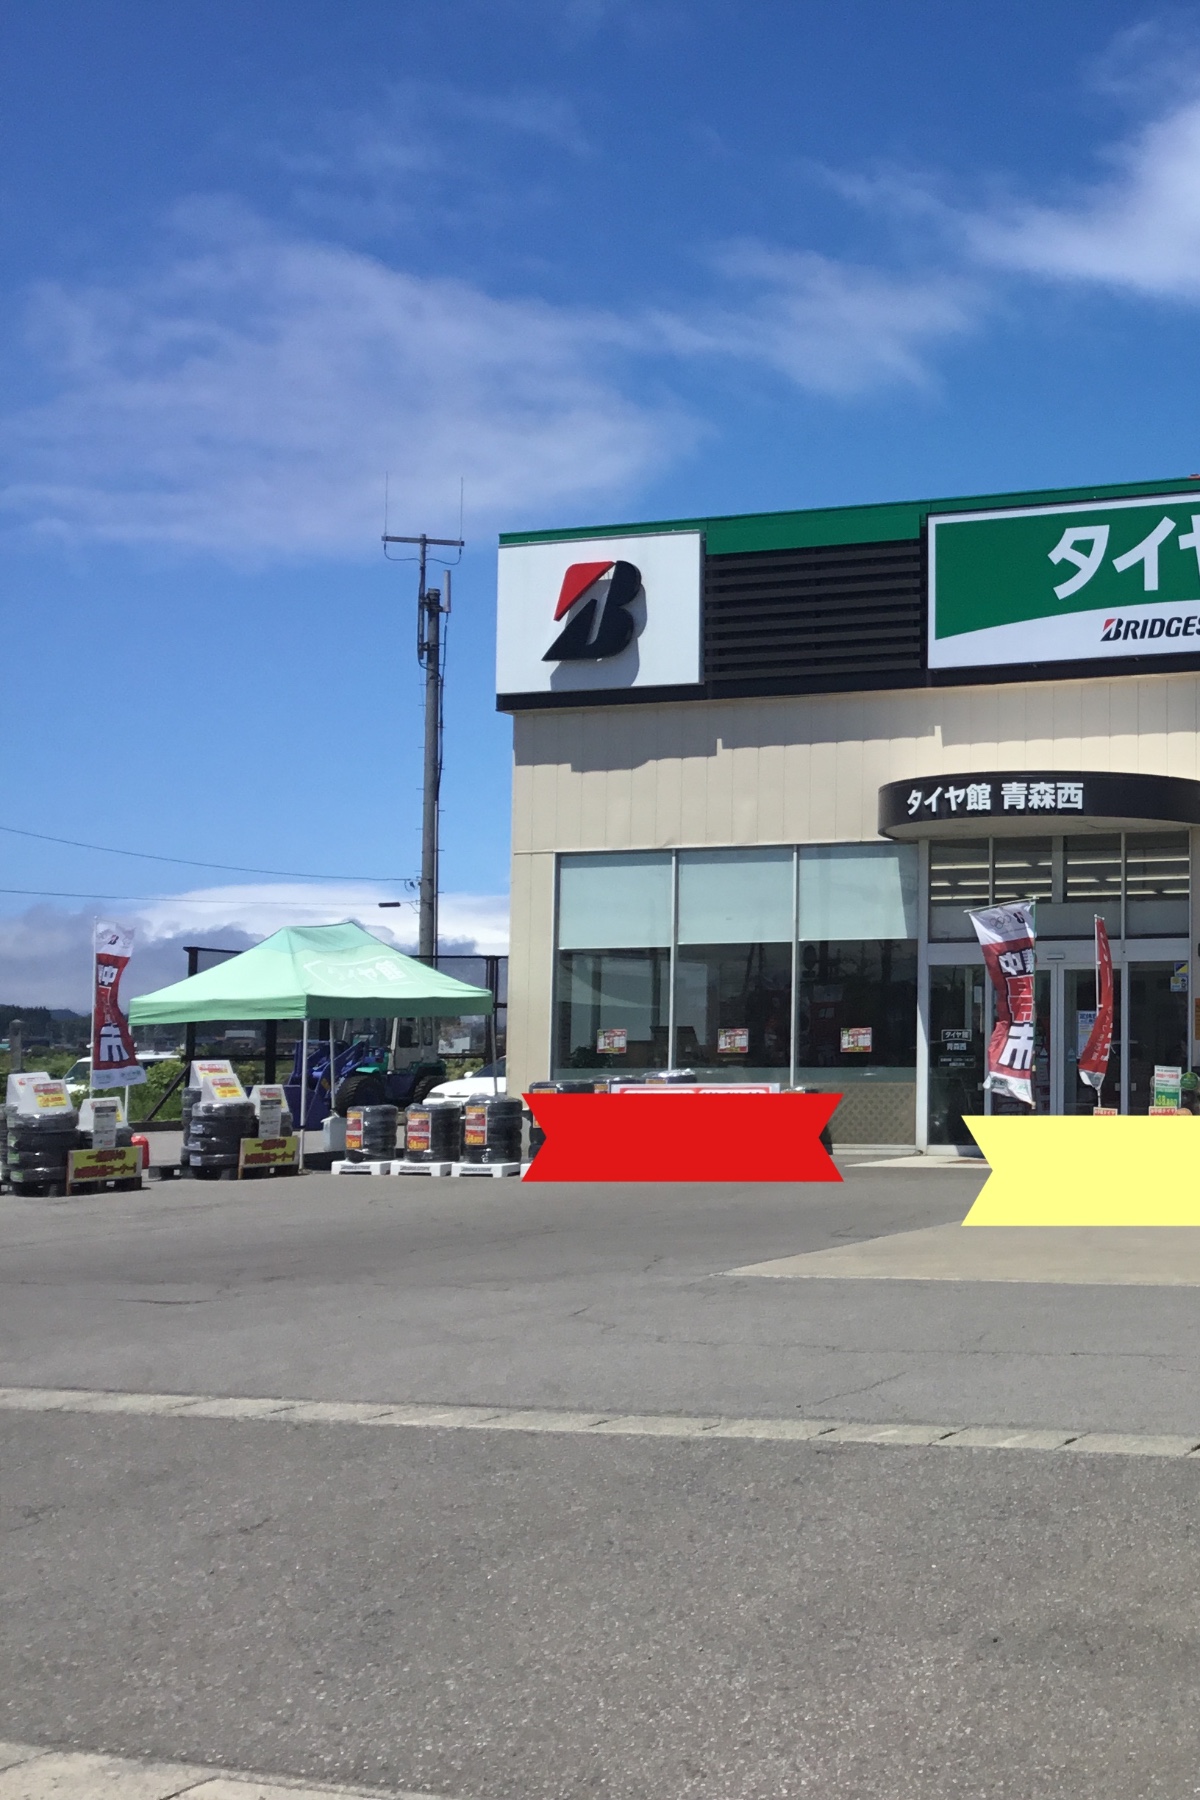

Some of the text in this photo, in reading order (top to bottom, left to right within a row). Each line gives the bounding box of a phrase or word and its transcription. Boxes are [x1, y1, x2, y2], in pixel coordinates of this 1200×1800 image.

[906, 782, 1084, 815] タイヤ館 青森西
